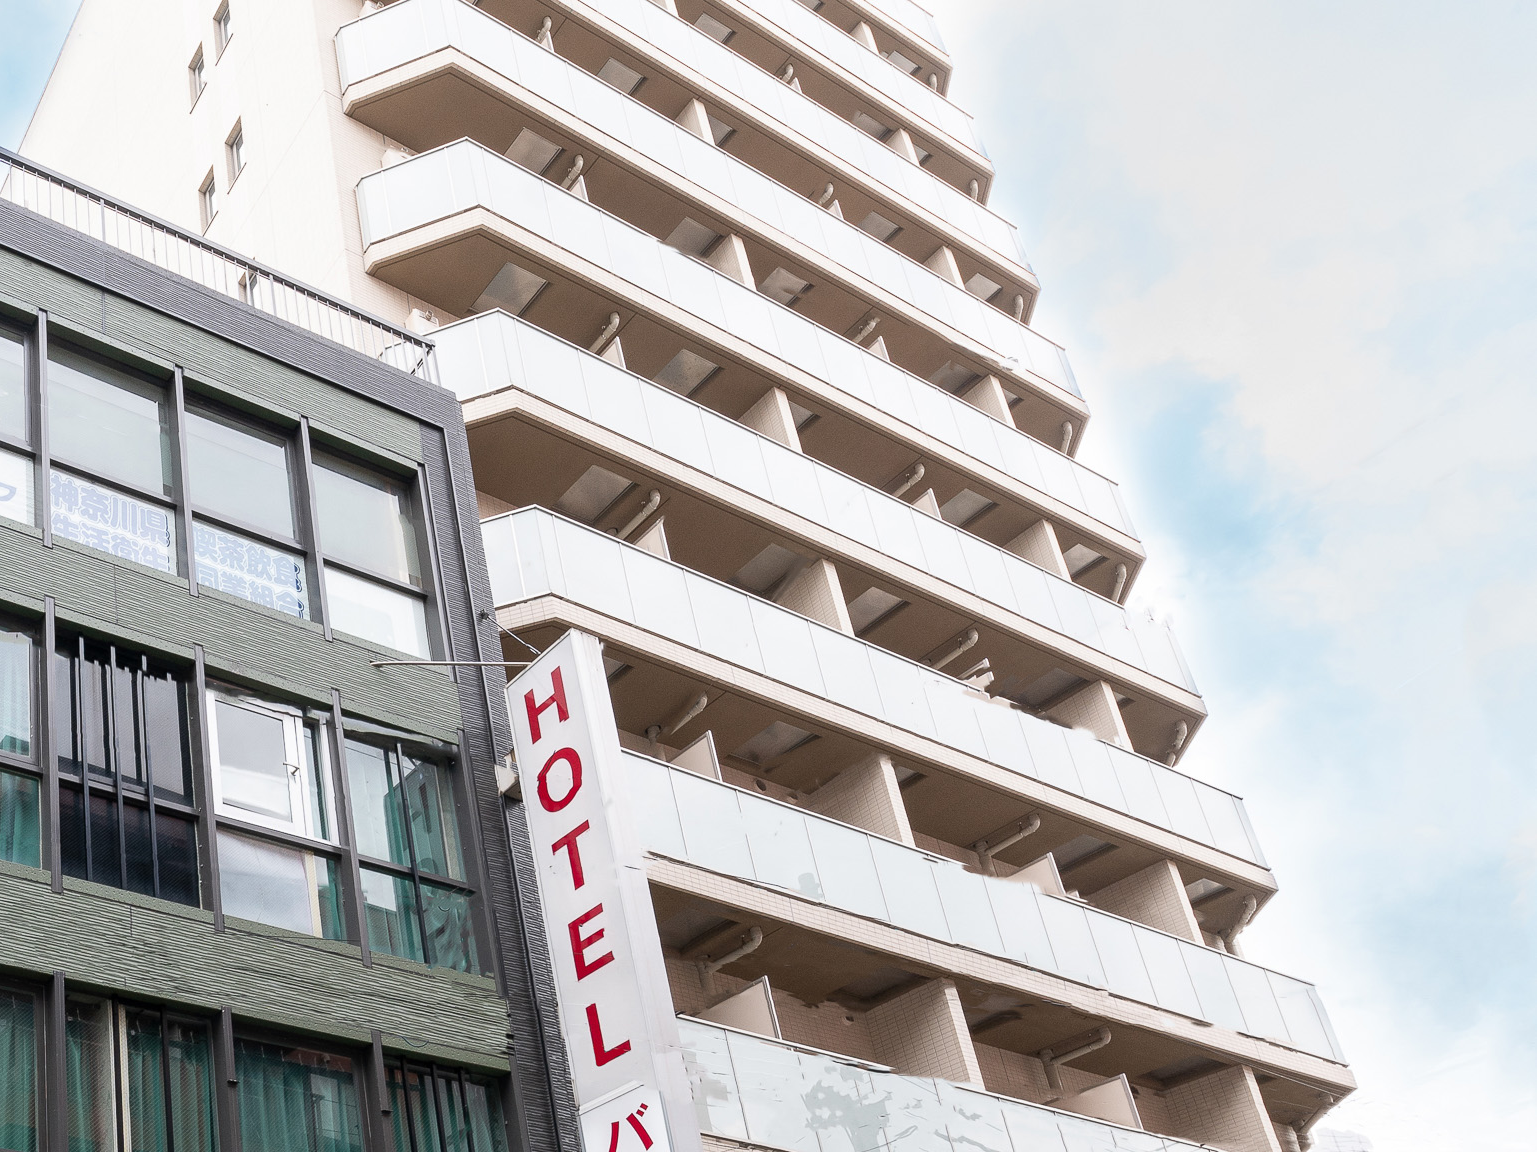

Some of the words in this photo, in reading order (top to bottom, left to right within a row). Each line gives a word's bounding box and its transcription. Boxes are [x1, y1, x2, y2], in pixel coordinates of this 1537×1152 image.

[50, 473, 171, 548] 神奈川県
[193, 524, 302, 592] 喫茶飲食
[523, 664, 632, 1069] HOTEL
